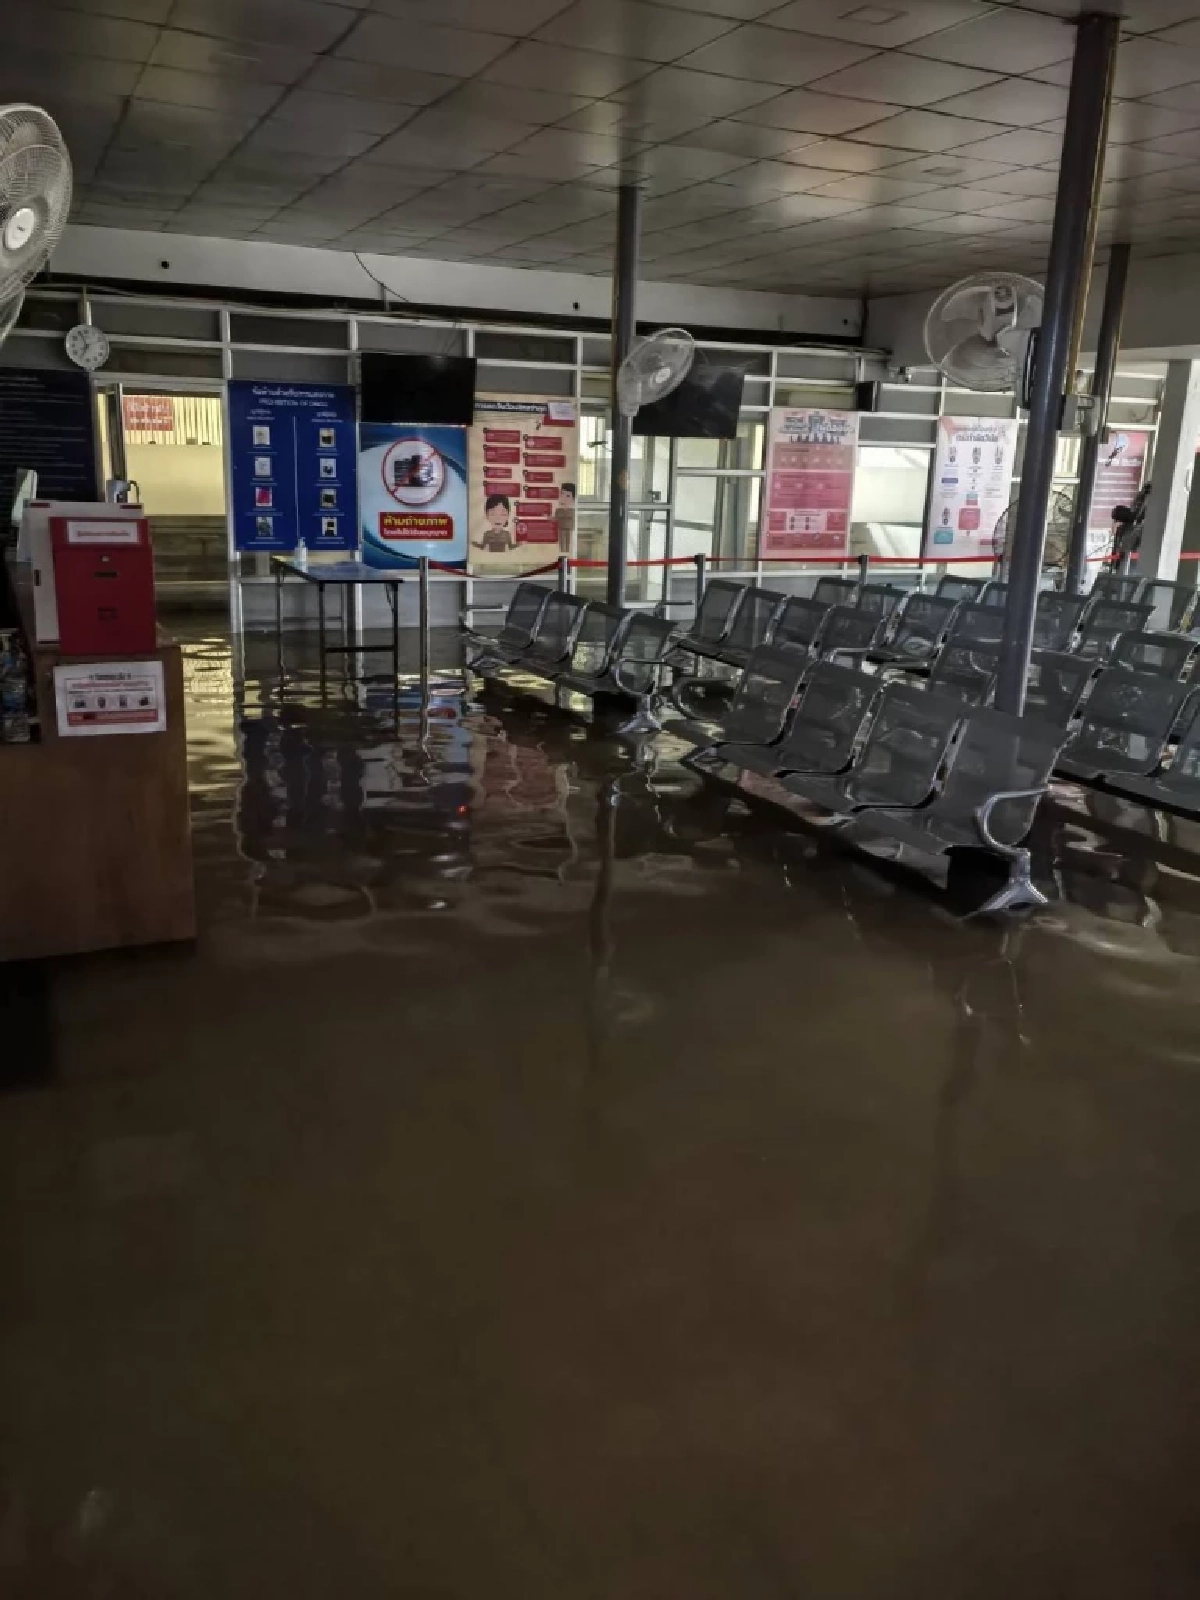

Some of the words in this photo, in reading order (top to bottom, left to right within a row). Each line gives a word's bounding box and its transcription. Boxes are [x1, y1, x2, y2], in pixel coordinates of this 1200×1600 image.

[383, 516, 448, 526] ห้ามถ่ายภาพ
